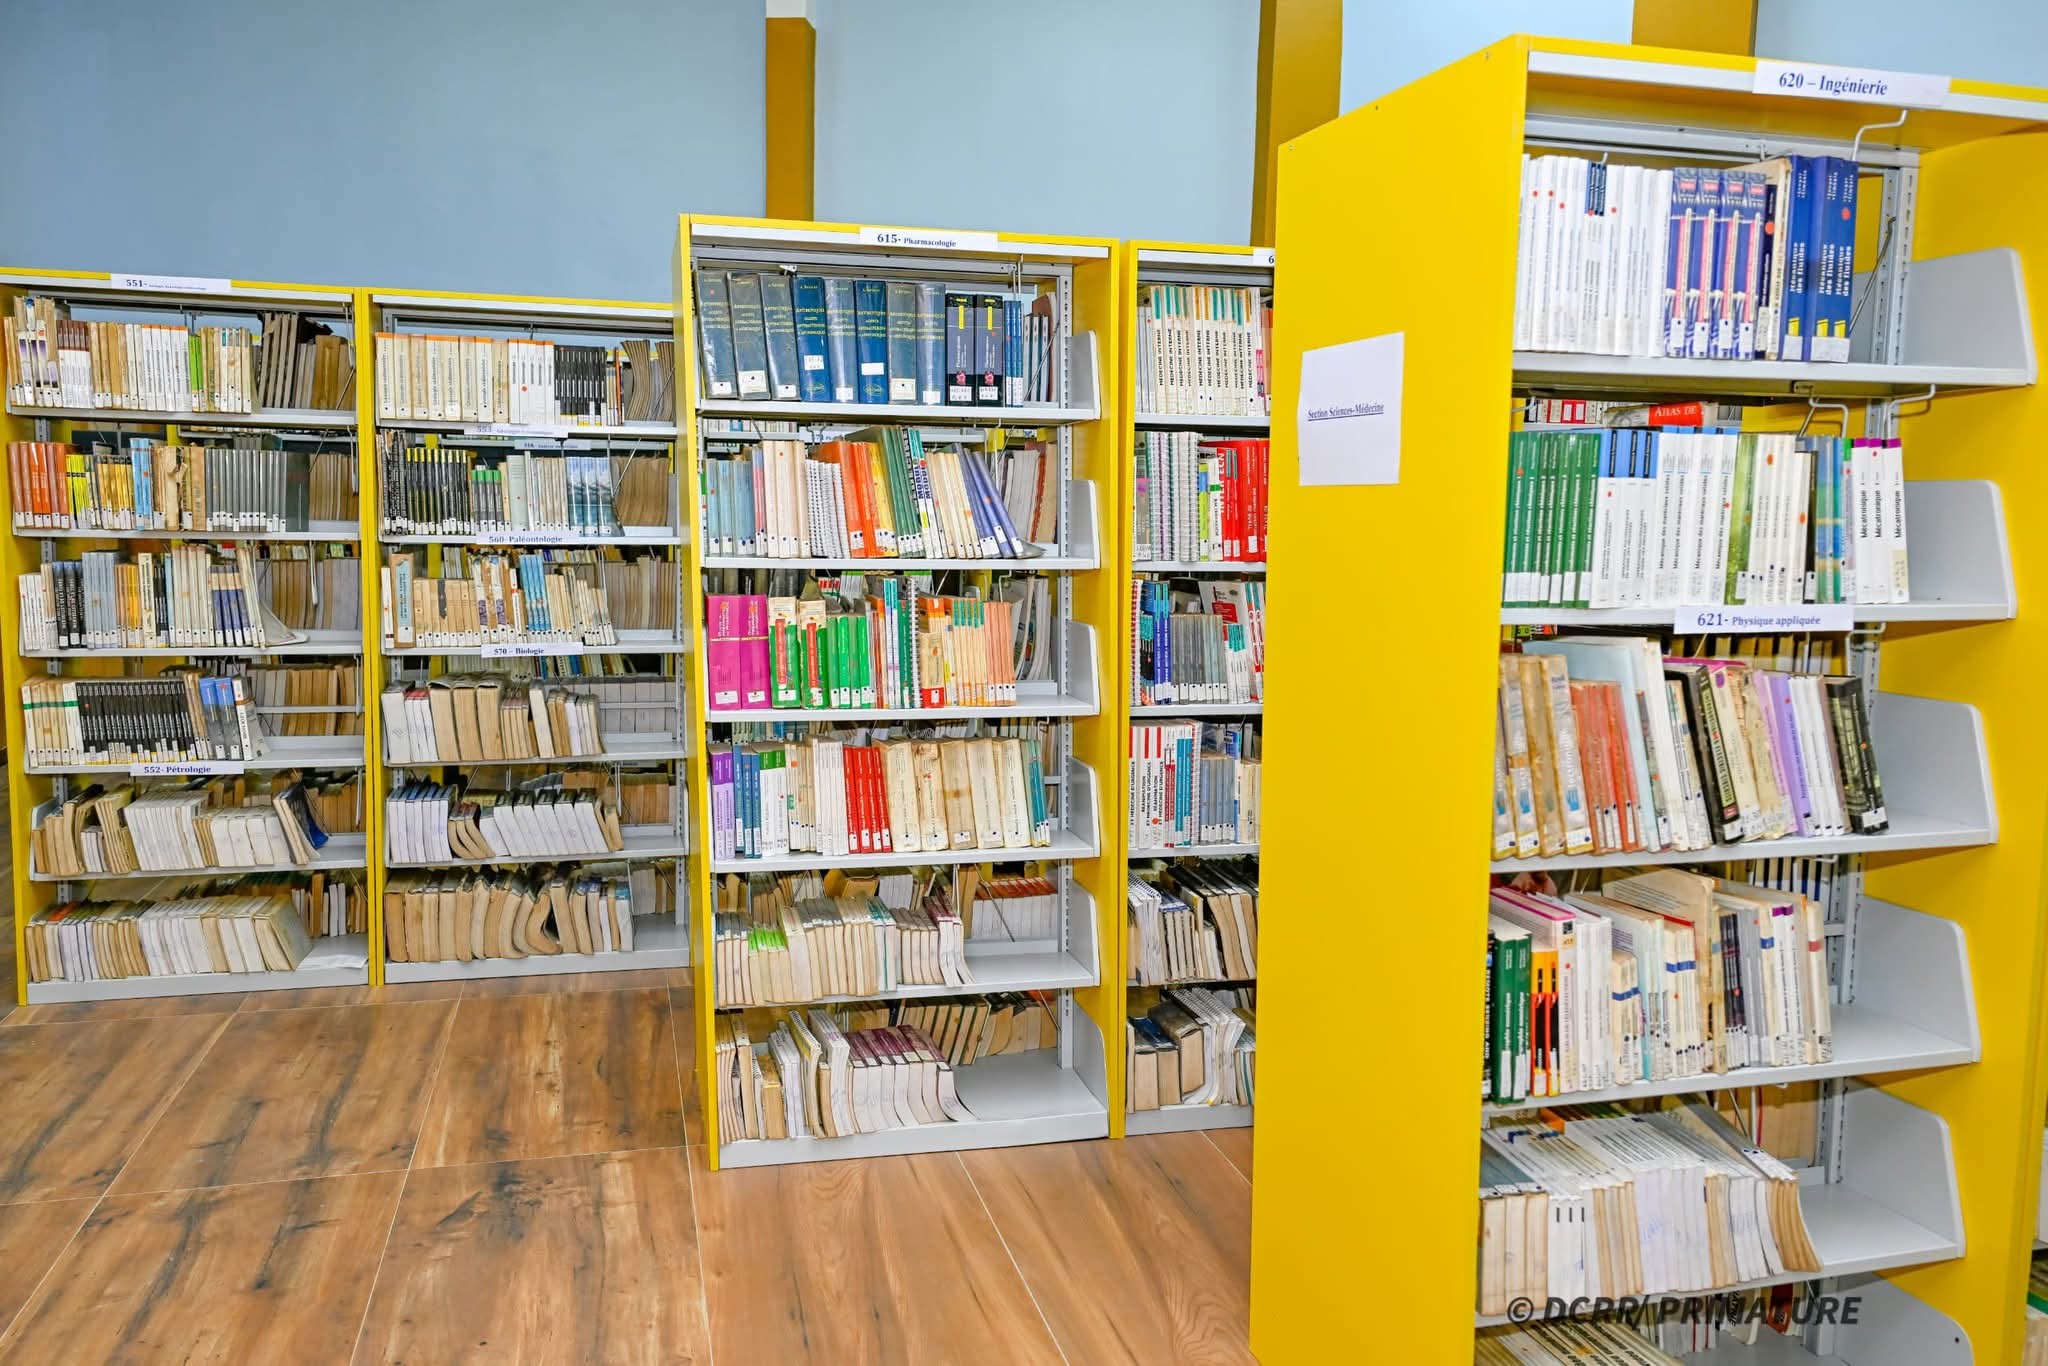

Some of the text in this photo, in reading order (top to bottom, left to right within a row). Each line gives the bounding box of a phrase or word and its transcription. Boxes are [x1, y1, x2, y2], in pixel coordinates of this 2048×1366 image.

[1779, 72, 1804, 89] 620
[1819, 75, 1888, 96] Ingénierie
[903, 237, 957, 248] Pharmacologie
[1655, 405, 1697, 417] ATLAS DE
[1697, 613, 1821, 627] 621- Physique appliquée
[515, 647, 545, 655] Biologie
[166, 765, 211, 774] Pétrologie
